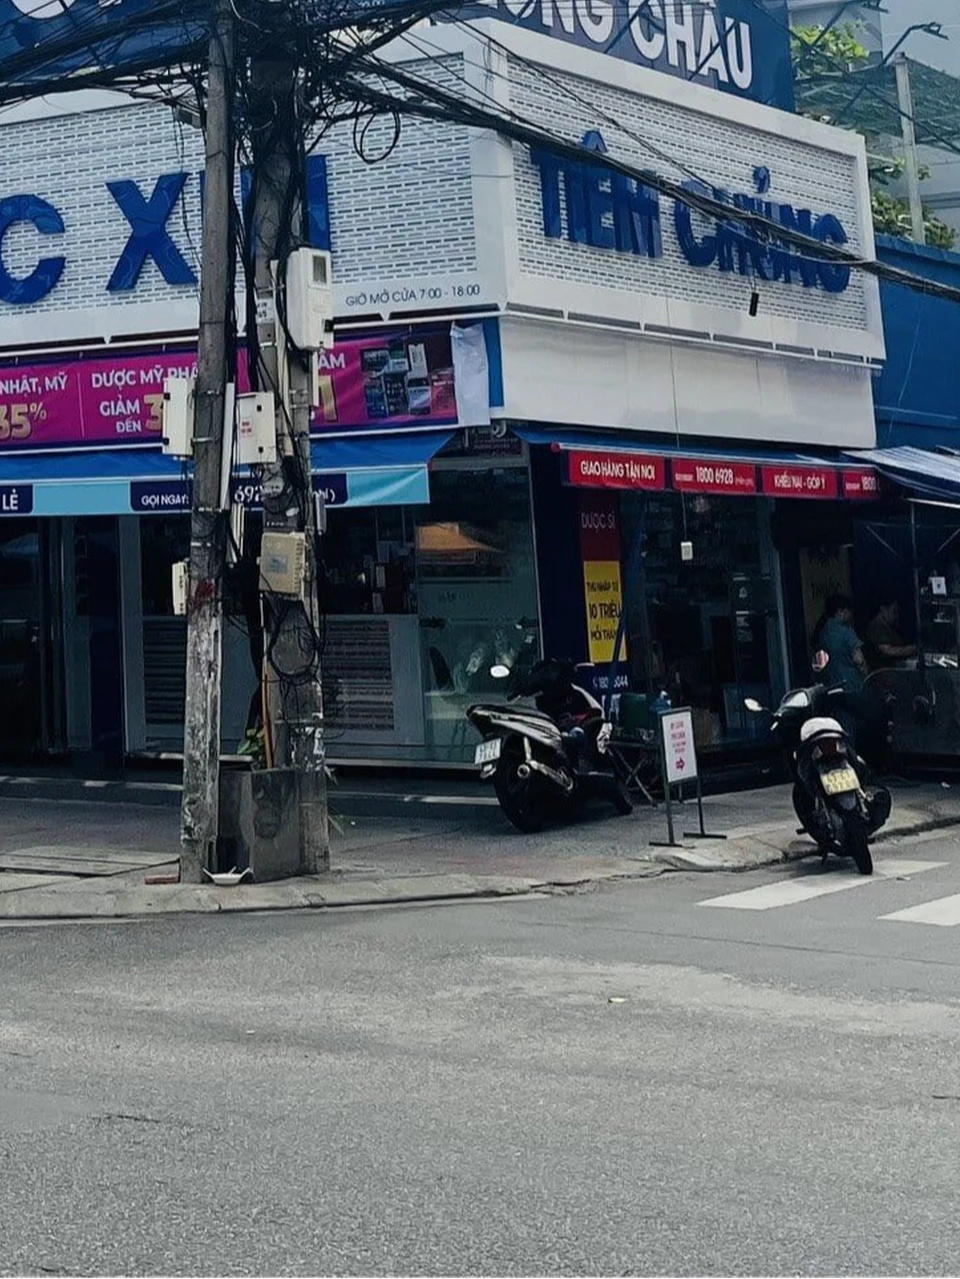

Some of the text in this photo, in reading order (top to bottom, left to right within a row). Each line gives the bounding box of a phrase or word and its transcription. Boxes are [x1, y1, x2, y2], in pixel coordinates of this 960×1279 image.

[529, 128, 663, 258] TIÊM
[345, 293, 367, 307] GIỜ
[369, 289, 390, 304] MỞ
[392, 287, 417, 302] CỬA
[0, 377, 42, 398] NHẬT,
[45, 371, 68, 391] MỸ
[91, 369, 136, 393] DƯỢC
[140, 365, 163, 384] MỸ
[99, 397, 141, 416] GIẢM
[116, 417, 141, 433] ĐẾN
[580, 460, 601, 475] GIAO
[600, 459, 624, 477] HÀNG
[625, 460, 640, 483] TẬN
[696, 466, 714, 484] 1800
[715, 468, 734, 485] 6928
[3, 488, 19, 511] LẺ
[141, 495, 160, 507] GỌI
[581, 513, 606, 534] DƯỢC
[589, 603, 598, 619] 10
